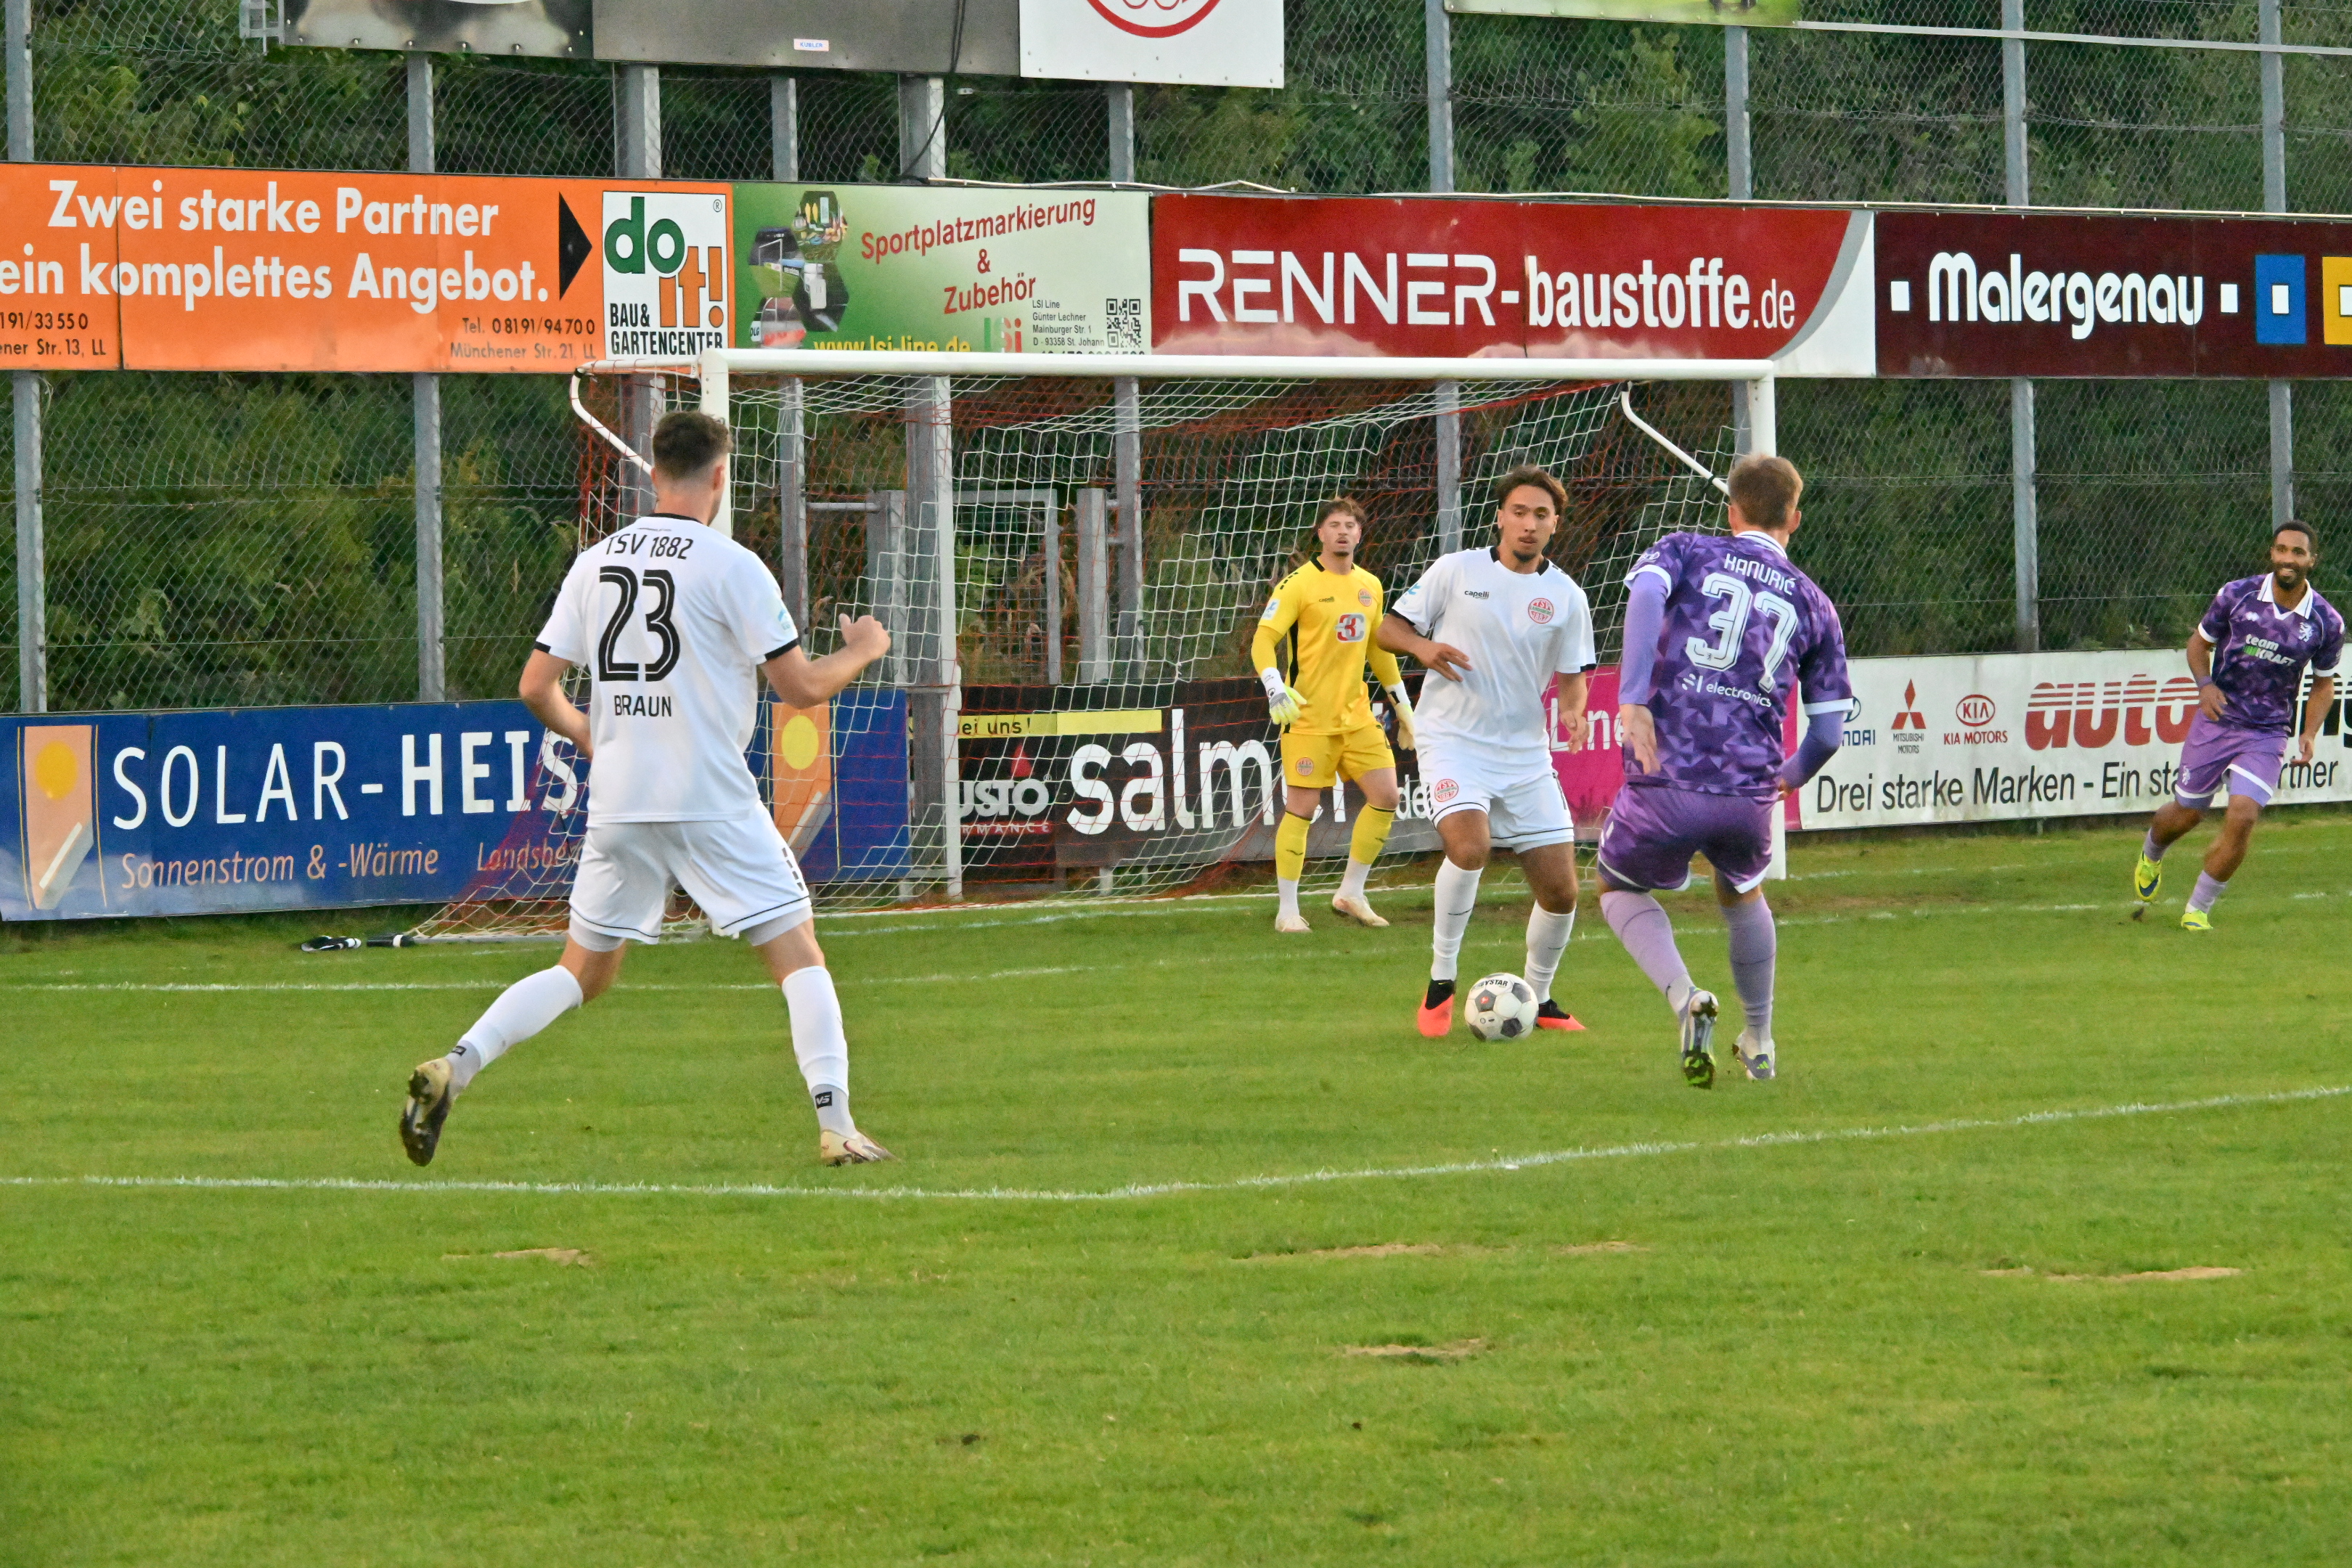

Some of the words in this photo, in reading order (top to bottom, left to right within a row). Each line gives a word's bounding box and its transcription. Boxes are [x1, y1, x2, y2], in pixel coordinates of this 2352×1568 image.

[48, 180, 163, 229] Zwei
[179, 181, 320, 232] starke
[336, 187, 499, 236] Partner
[605, 197, 685, 274] do
[862, 198, 1095, 264] Sportplatzmarkierung
[977, 249, 991, 274] &
[0, 243, 63, 294] ein
[81, 243, 332, 311] komplettes
[348, 250, 549, 314] Angebot.
[658, 246, 724, 327] it!
[944, 272, 1036, 314] Zubehör
[1032, 300, 1043, 309] LSI
[1045, 300, 1060, 309] Line
[1929, 252, 2203, 340] Malergenau
[462, 317, 486, 334] Tel.
[1033, 312, 1055, 321] Günter
[1058, 312, 1086, 322] Lechner
[1033, 324, 1072, 335] Mainburger
[1074, 325, 1085, 334] Str.
[451, 340, 526, 359] Münchener
[611, 331, 722, 355] GARTENCENTER
[1079, 338, 1105, 346] Johann
[606, 533, 647, 555] TSV
[650, 536, 693, 560] 1882
[1464, 589, 1490, 599] capelli
[598, 565, 680, 682] 23
[1686, 572, 1798, 693] 37
[2246, 634, 2279, 651] team
[615, 695, 672, 716] BRAUN
[1706, 683, 1773, 708] electronics
[1963, 703, 1990, 719] KIA
[1842, 730, 1876, 746] NDAI
[1893, 733, 1924, 743] MITSUBISHI
[1898, 745, 1920, 754] MOTORS
[1943, 732, 1961, 745] KIA
[1964, 730, 2009, 745] MOTORS
[1817, 773, 1872, 813] Drei
[1882, 769, 1963, 810] starke
[1973, 765, 2075, 806] Marken
[2102, 761, 2140, 799] Ein
[122, 851, 294, 889] Sonnenstrom
[307, 844, 326, 879] &
